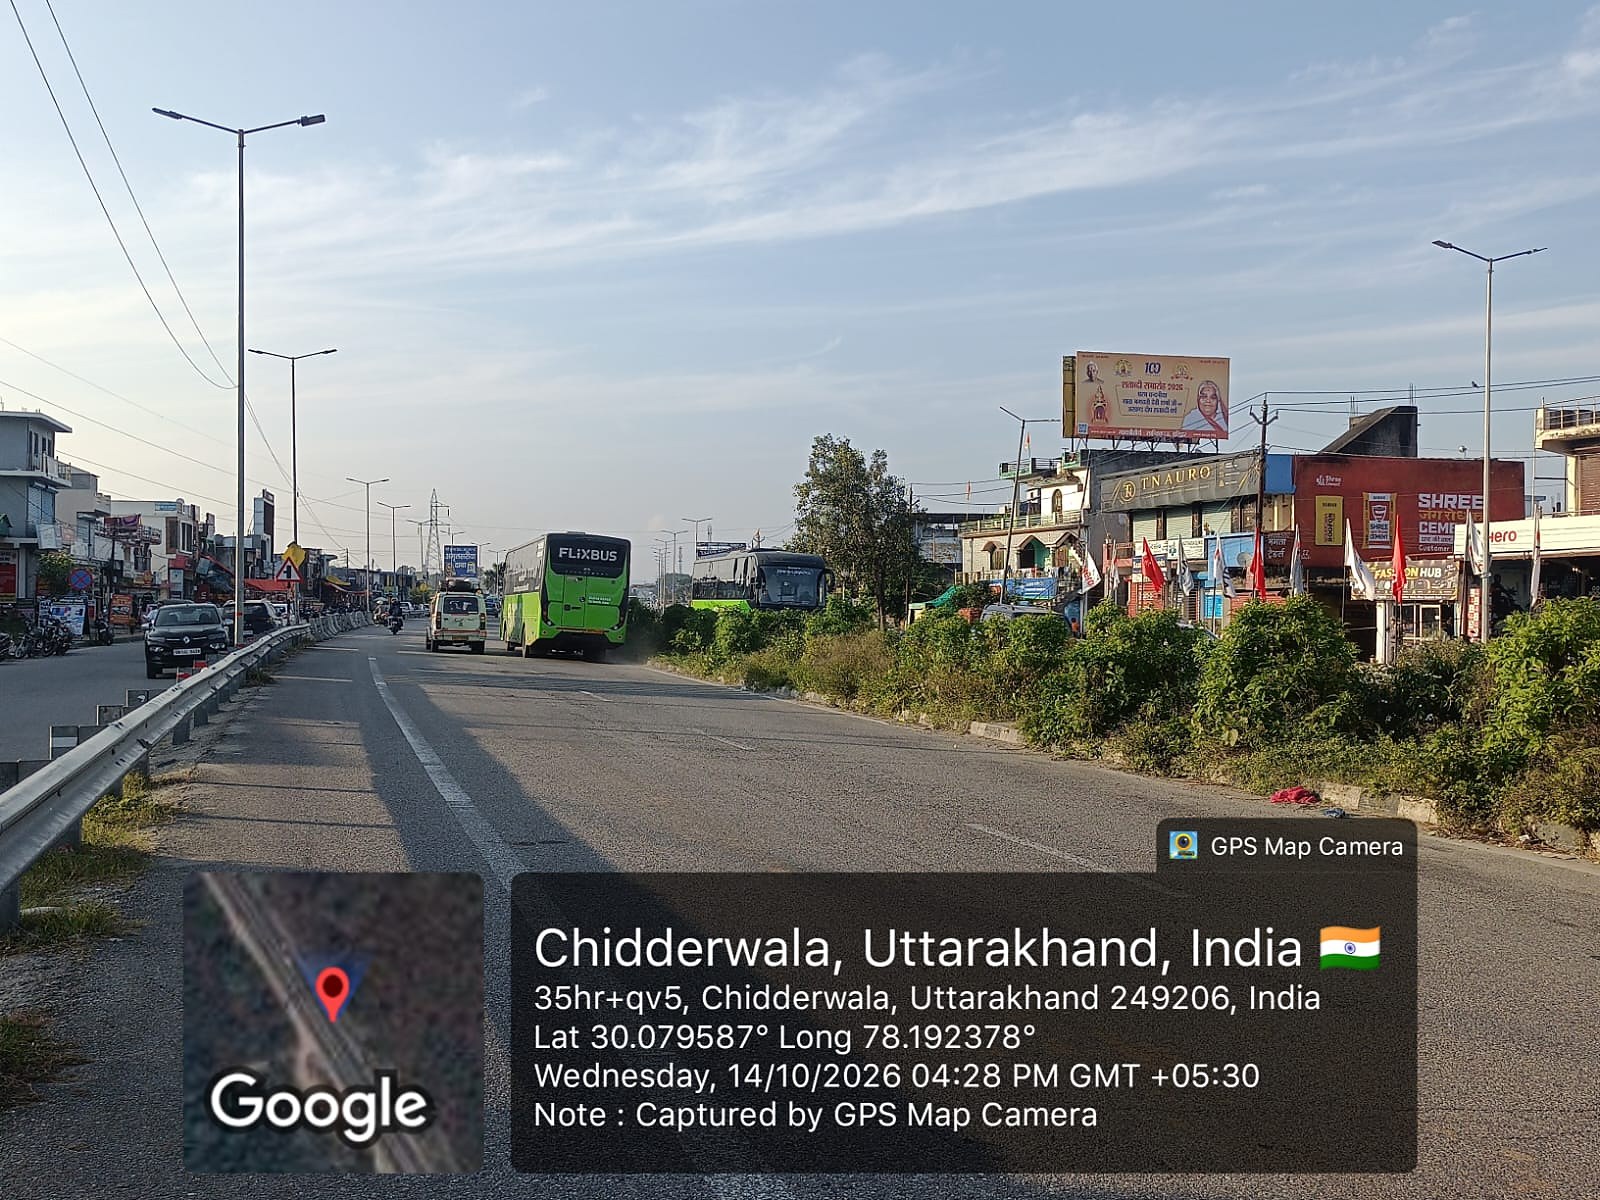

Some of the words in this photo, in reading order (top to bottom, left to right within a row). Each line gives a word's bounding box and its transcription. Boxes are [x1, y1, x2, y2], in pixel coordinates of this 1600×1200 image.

[1418, 494, 1484, 509] SHREE
[1374, 567, 1419, 579] FASON
[1420, 567, 1442, 578] HUB
